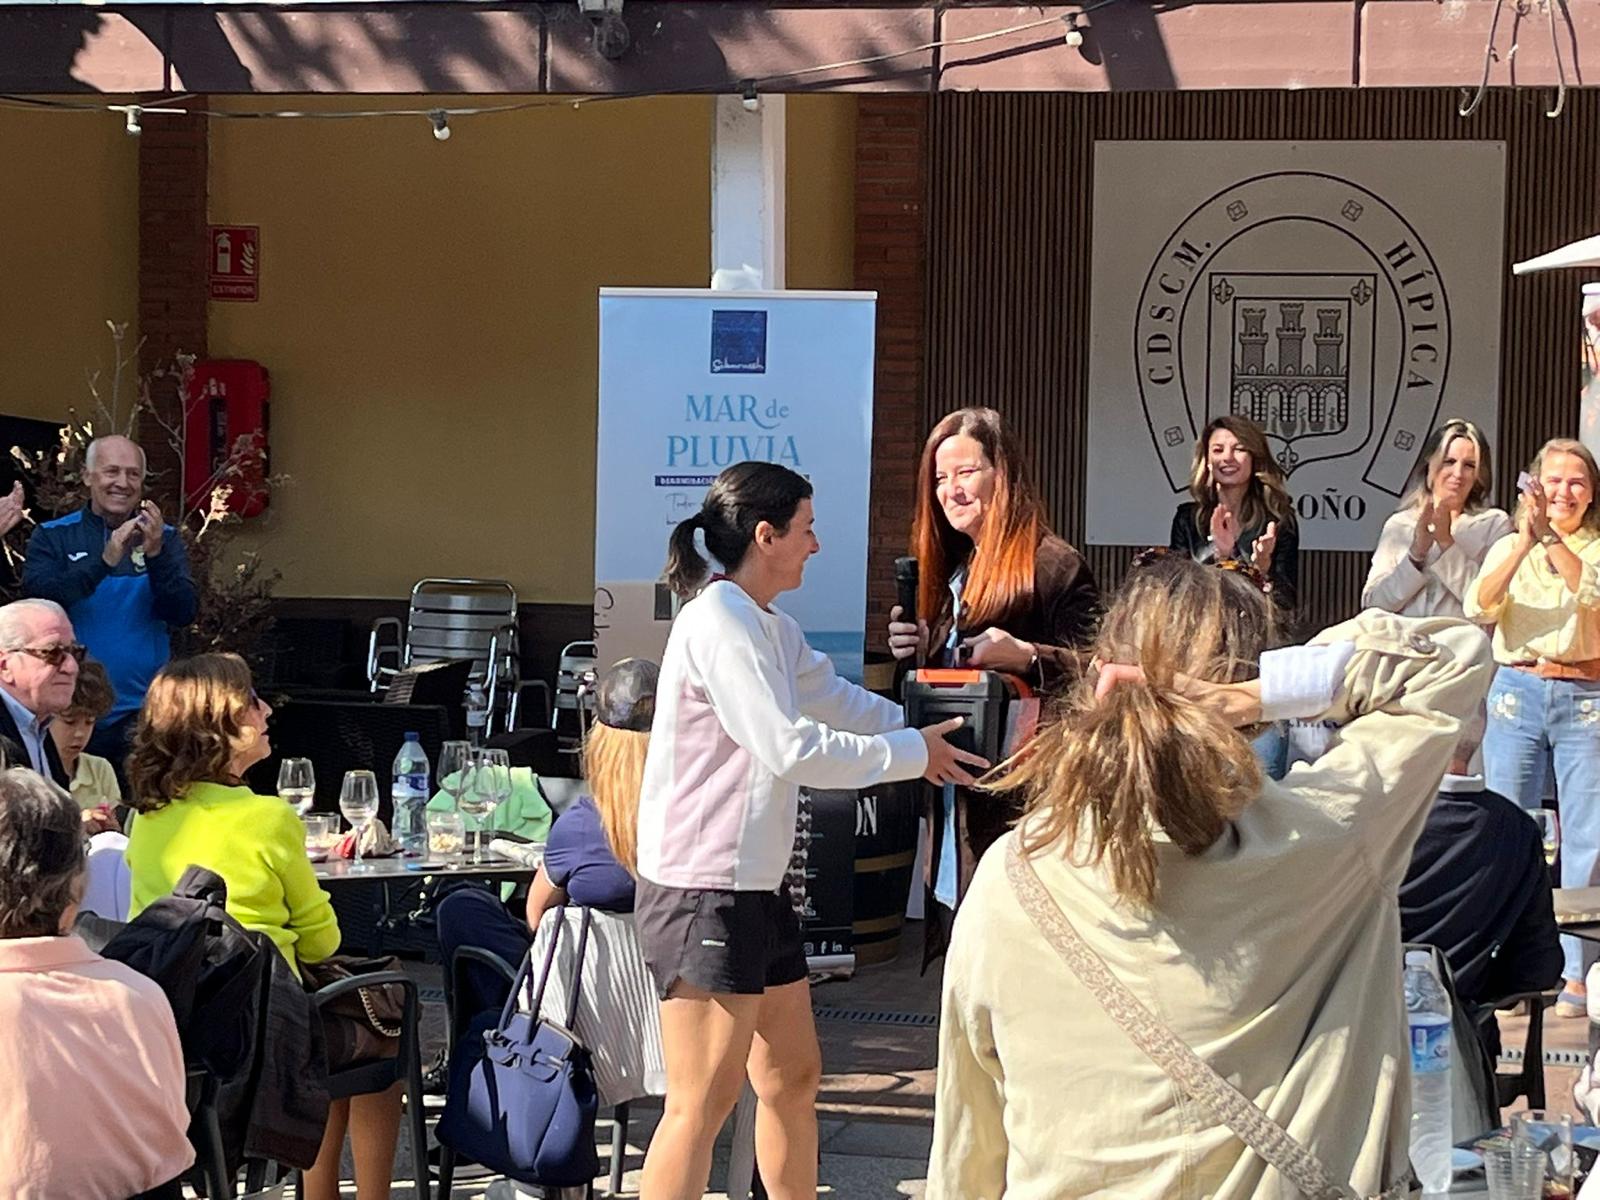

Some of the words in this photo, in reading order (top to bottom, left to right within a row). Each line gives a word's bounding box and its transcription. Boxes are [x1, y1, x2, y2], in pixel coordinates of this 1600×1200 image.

[1146, 239, 1212, 385] CDSCM.
[1384, 240, 1439, 390] HÍPICA
[685, 394, 781, 430] MAR
[765, 399, 789, 419] de
[666, 435, 802, 467] PLUVIA
[1297, 487, 1366, 521] OÑO
